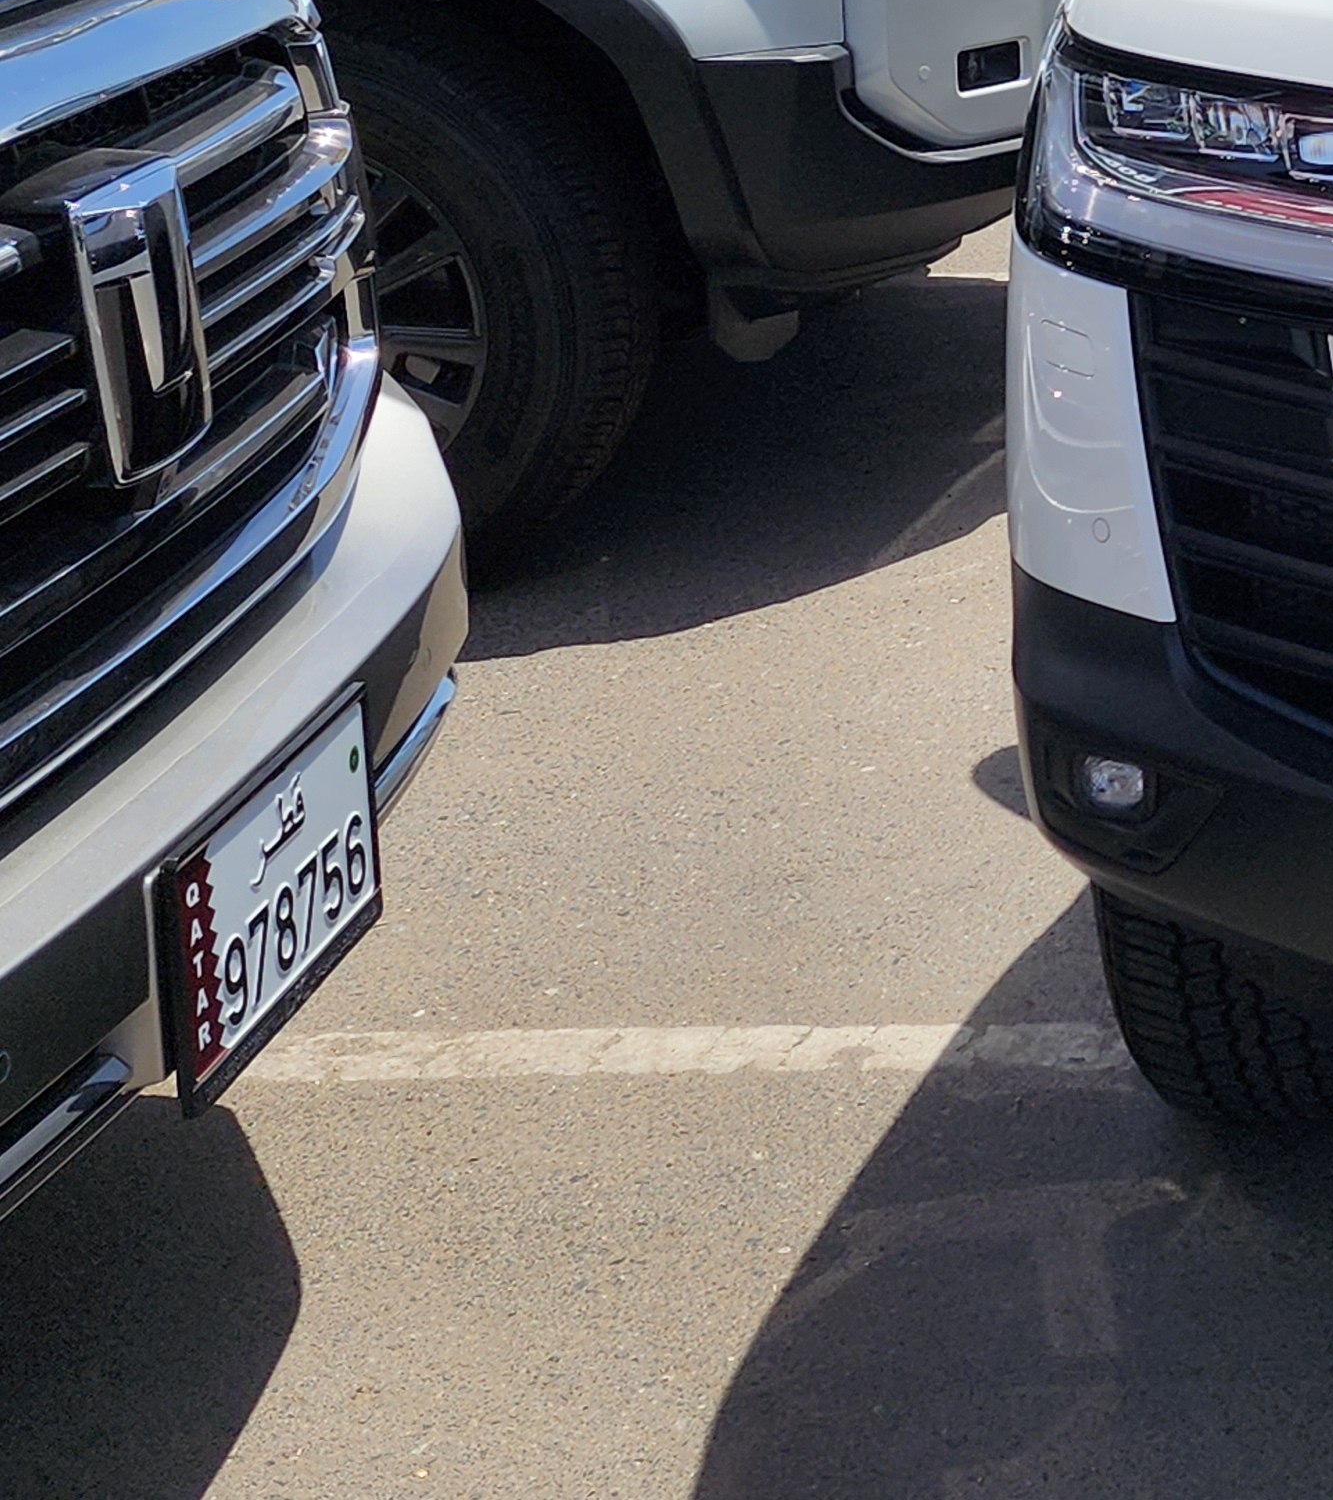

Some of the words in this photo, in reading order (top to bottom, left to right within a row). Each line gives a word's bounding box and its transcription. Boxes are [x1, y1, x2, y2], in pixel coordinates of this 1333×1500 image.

[249, 771, 306, 890] قطر
[185, 881, 213, 1052] QATAR
[222, 809, 367, 1028] 978756
